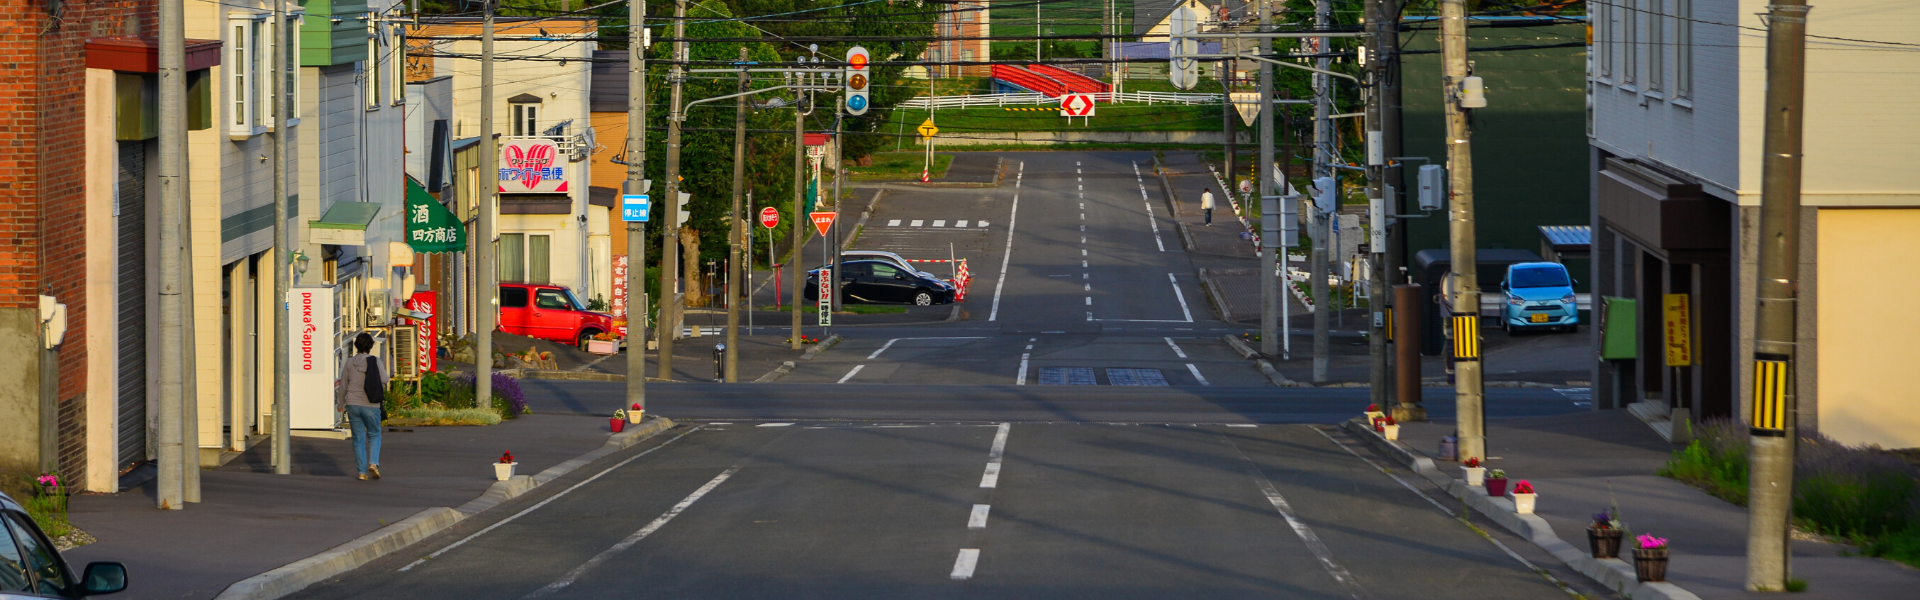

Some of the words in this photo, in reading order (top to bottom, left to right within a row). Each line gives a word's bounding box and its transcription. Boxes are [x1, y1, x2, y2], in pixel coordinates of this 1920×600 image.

[499, 167, 563, 180] ホワイト急便
[412, 204, 429, 224] 酒
[624, 208, 647, 217] 停止線
[412, 226, 457, 243] 四方商店
[821, 270, 830, 300] あぶない!!
[821, 301, 830, 325] 一時停止
